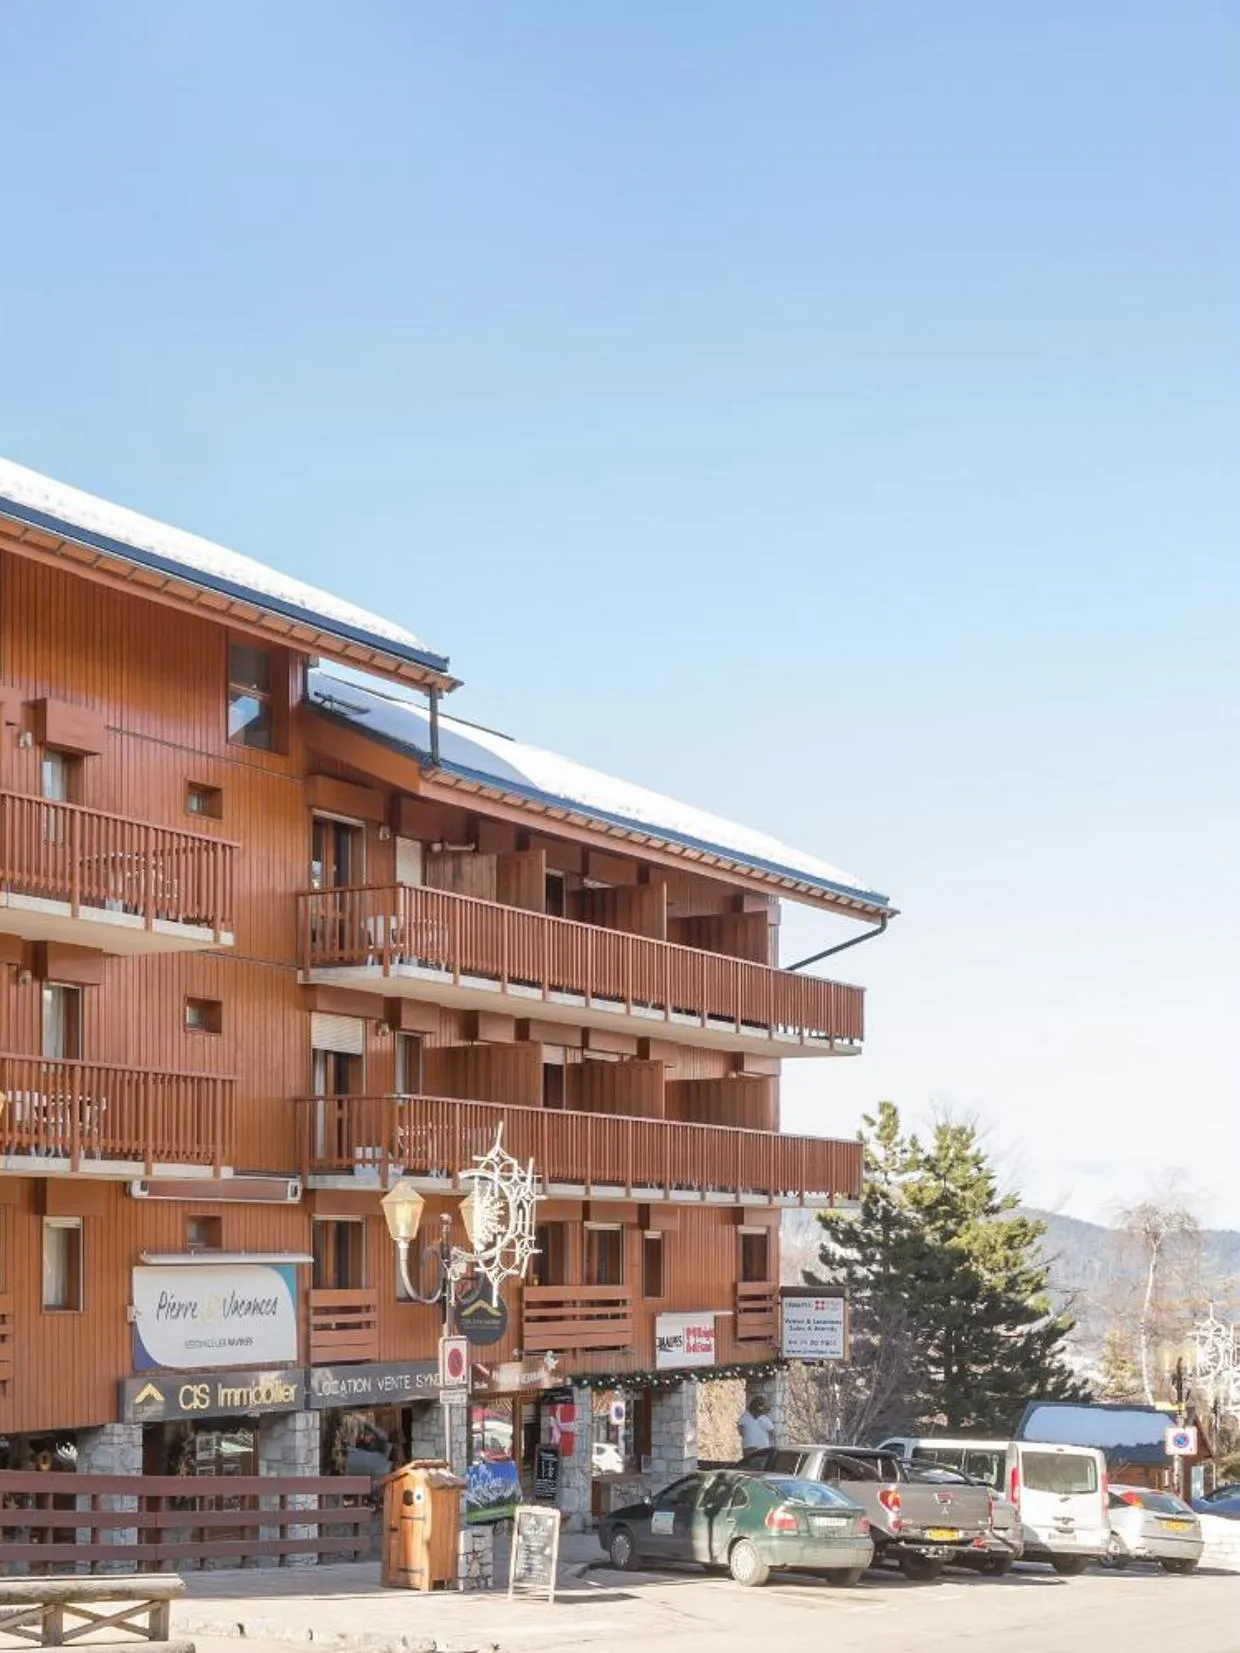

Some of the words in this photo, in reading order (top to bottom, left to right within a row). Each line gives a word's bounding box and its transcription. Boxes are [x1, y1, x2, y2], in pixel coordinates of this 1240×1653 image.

[156, 1289, 198, 1321] Pierre
[223, 1289, 278, 1320] Vacances
[316, 1377, 372, 1397] LOCATION
[377, 1374, 411, 1392] VENTE
